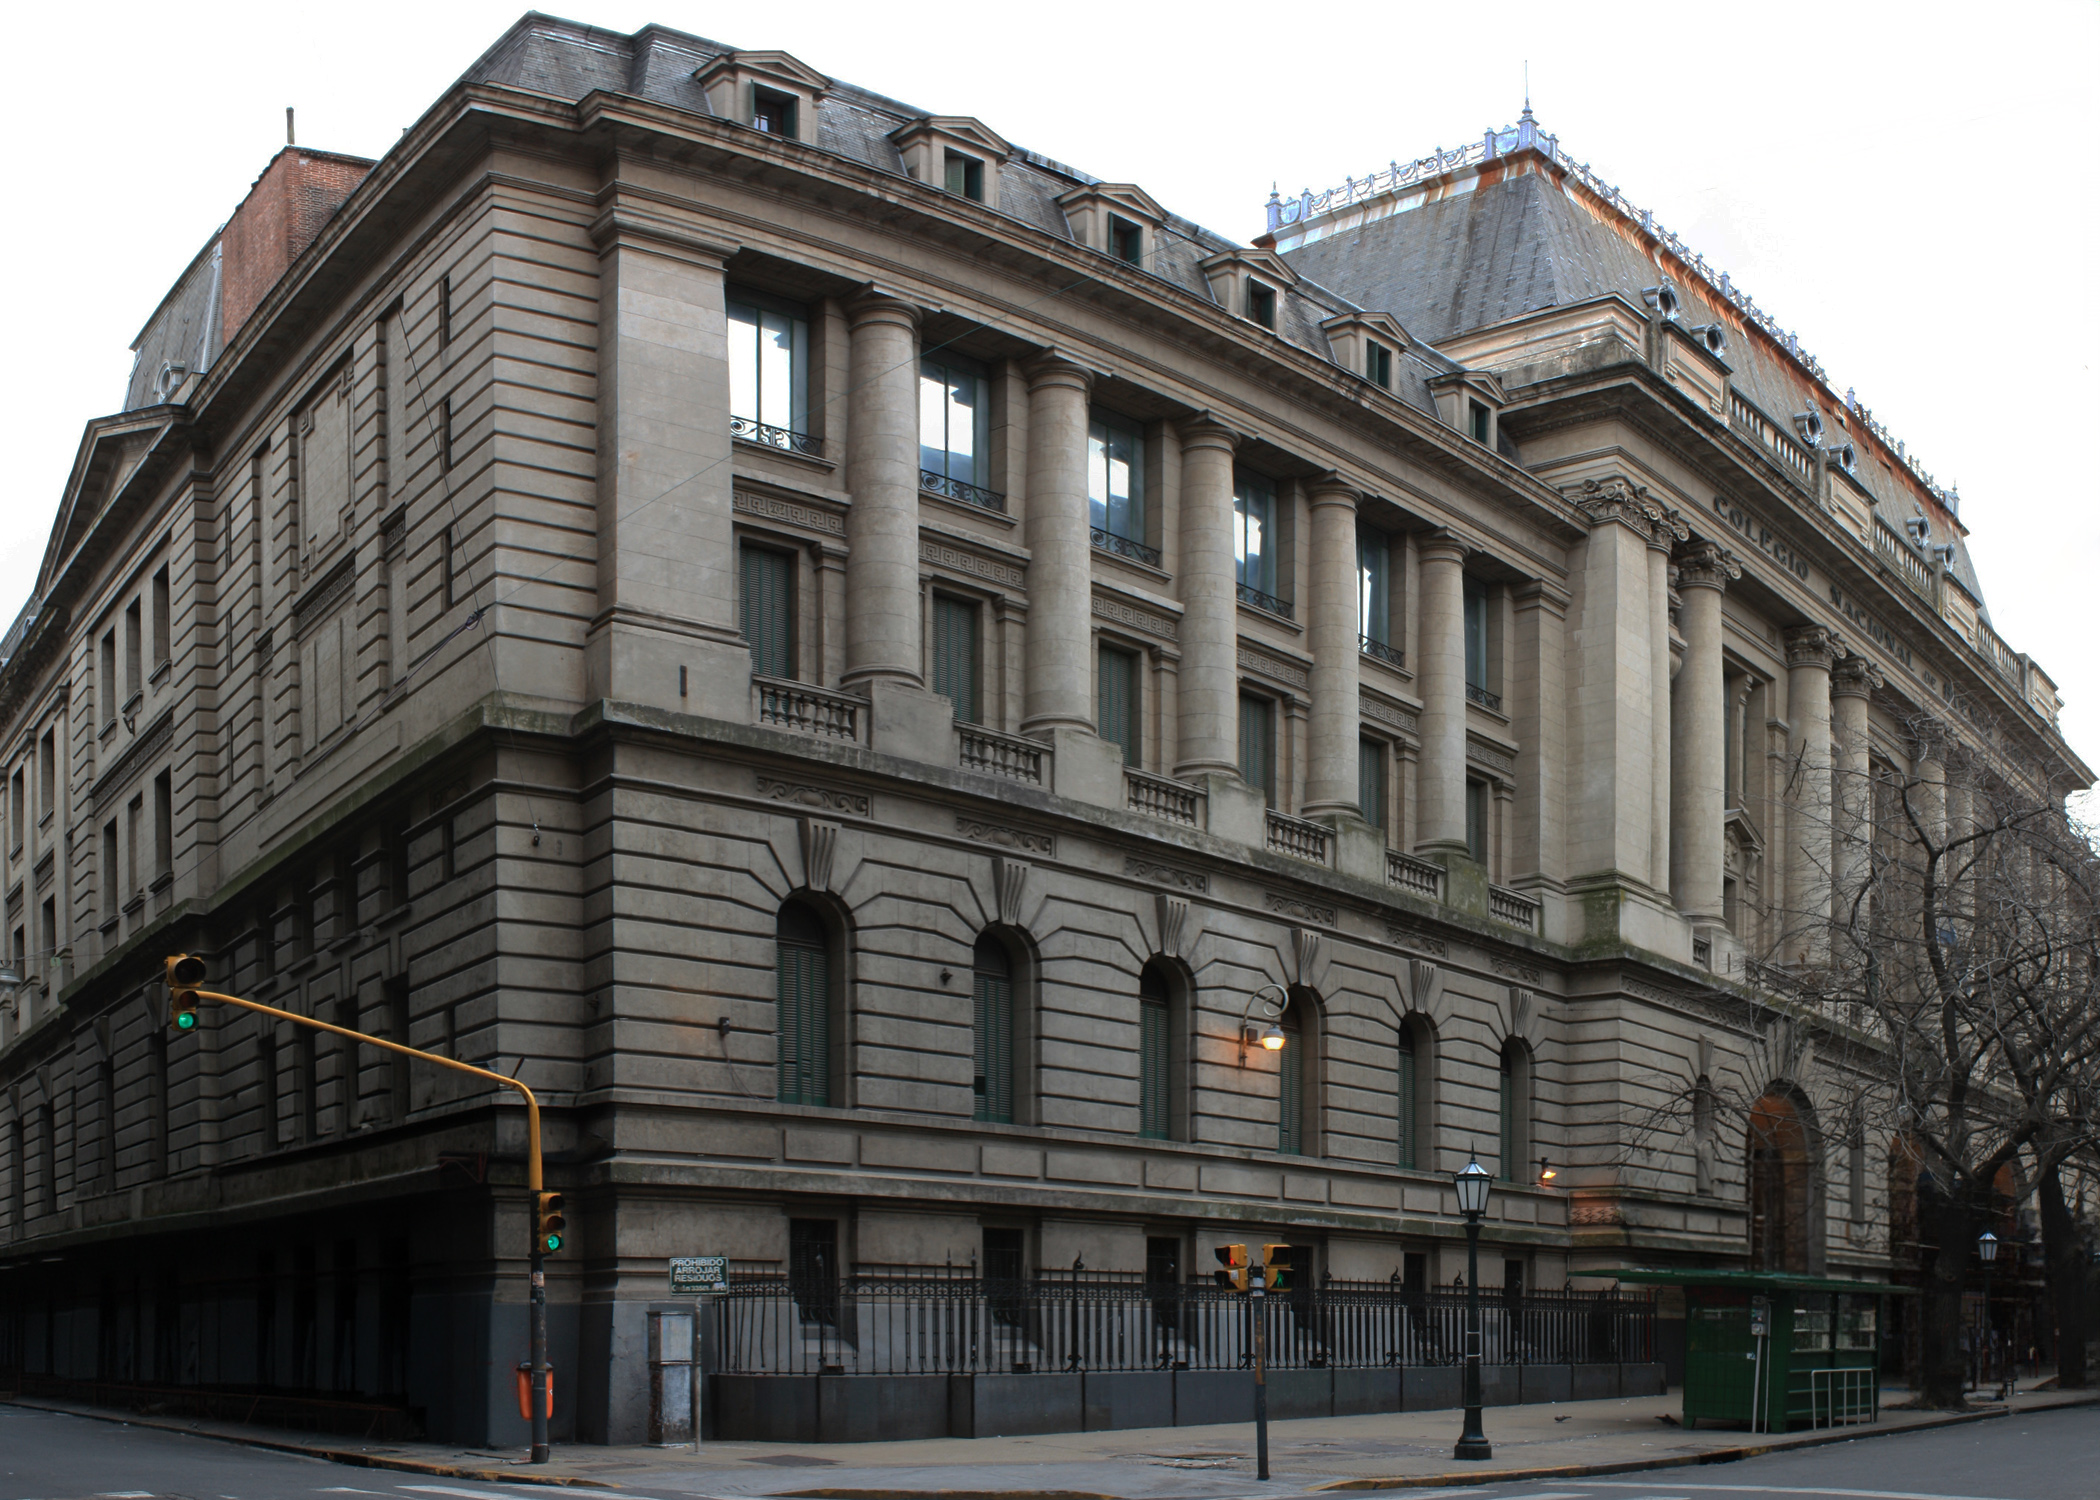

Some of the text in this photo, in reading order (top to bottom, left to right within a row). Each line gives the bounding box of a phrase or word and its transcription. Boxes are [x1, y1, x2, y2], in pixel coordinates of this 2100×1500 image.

[1713, 495, 1809, 581] COLEGIO
[1830, 584, 1915, 672] NACIONAL
[671, 1259, 724, 1267] PROHIBIDO
[675, 1266, 721, 1274] ARROJAR
[674, 1274, 723, 1282] RESIDUOS
